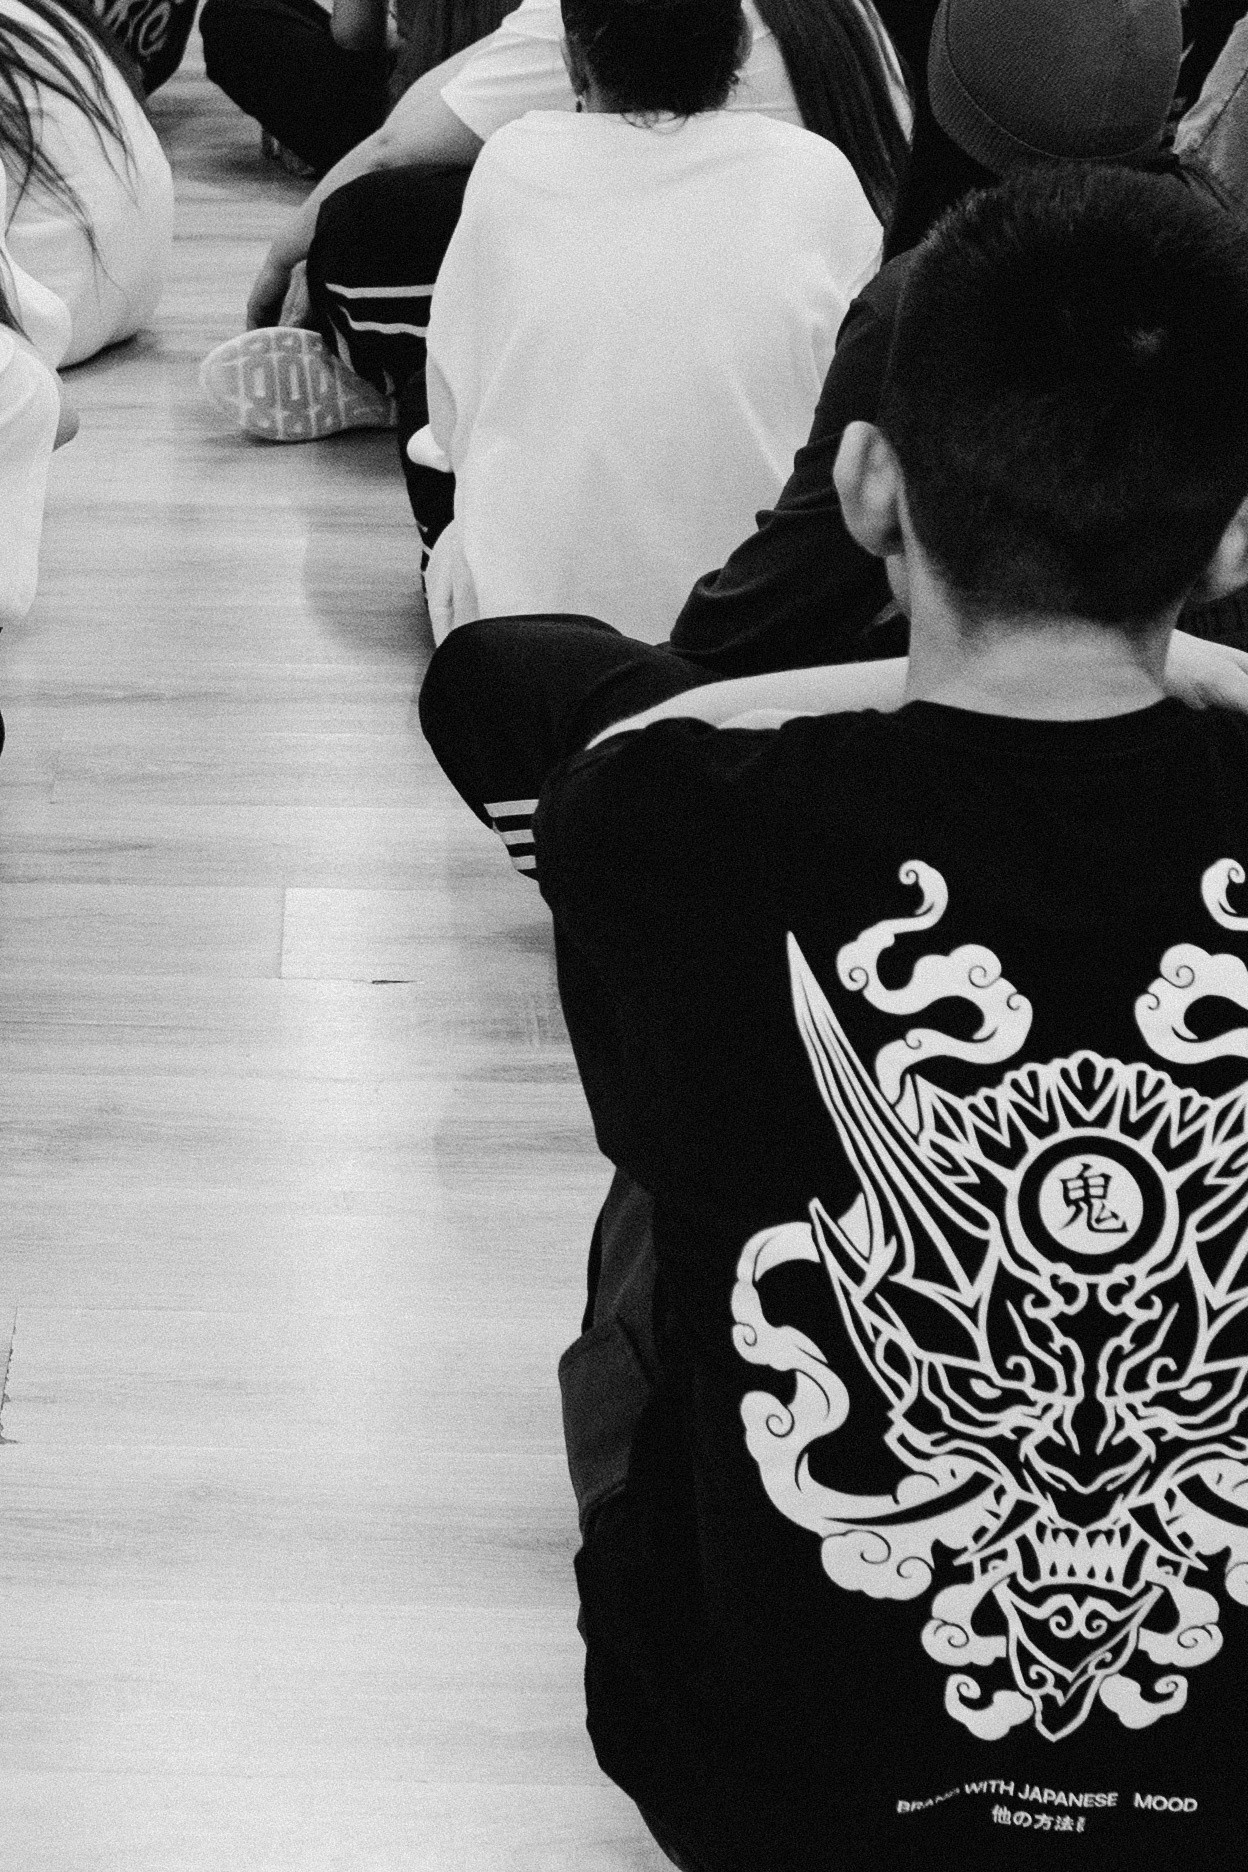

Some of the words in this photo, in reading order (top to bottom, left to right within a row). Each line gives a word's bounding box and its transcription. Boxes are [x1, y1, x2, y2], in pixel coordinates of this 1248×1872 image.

[1060, 1162, 1129, 1233] 鬼
[964, 1780, 1014, 1797] WITH
[1018, 1783, 1119, 1808] JAPANESE
[1133, 1792, 1198, 1813] MOOD
